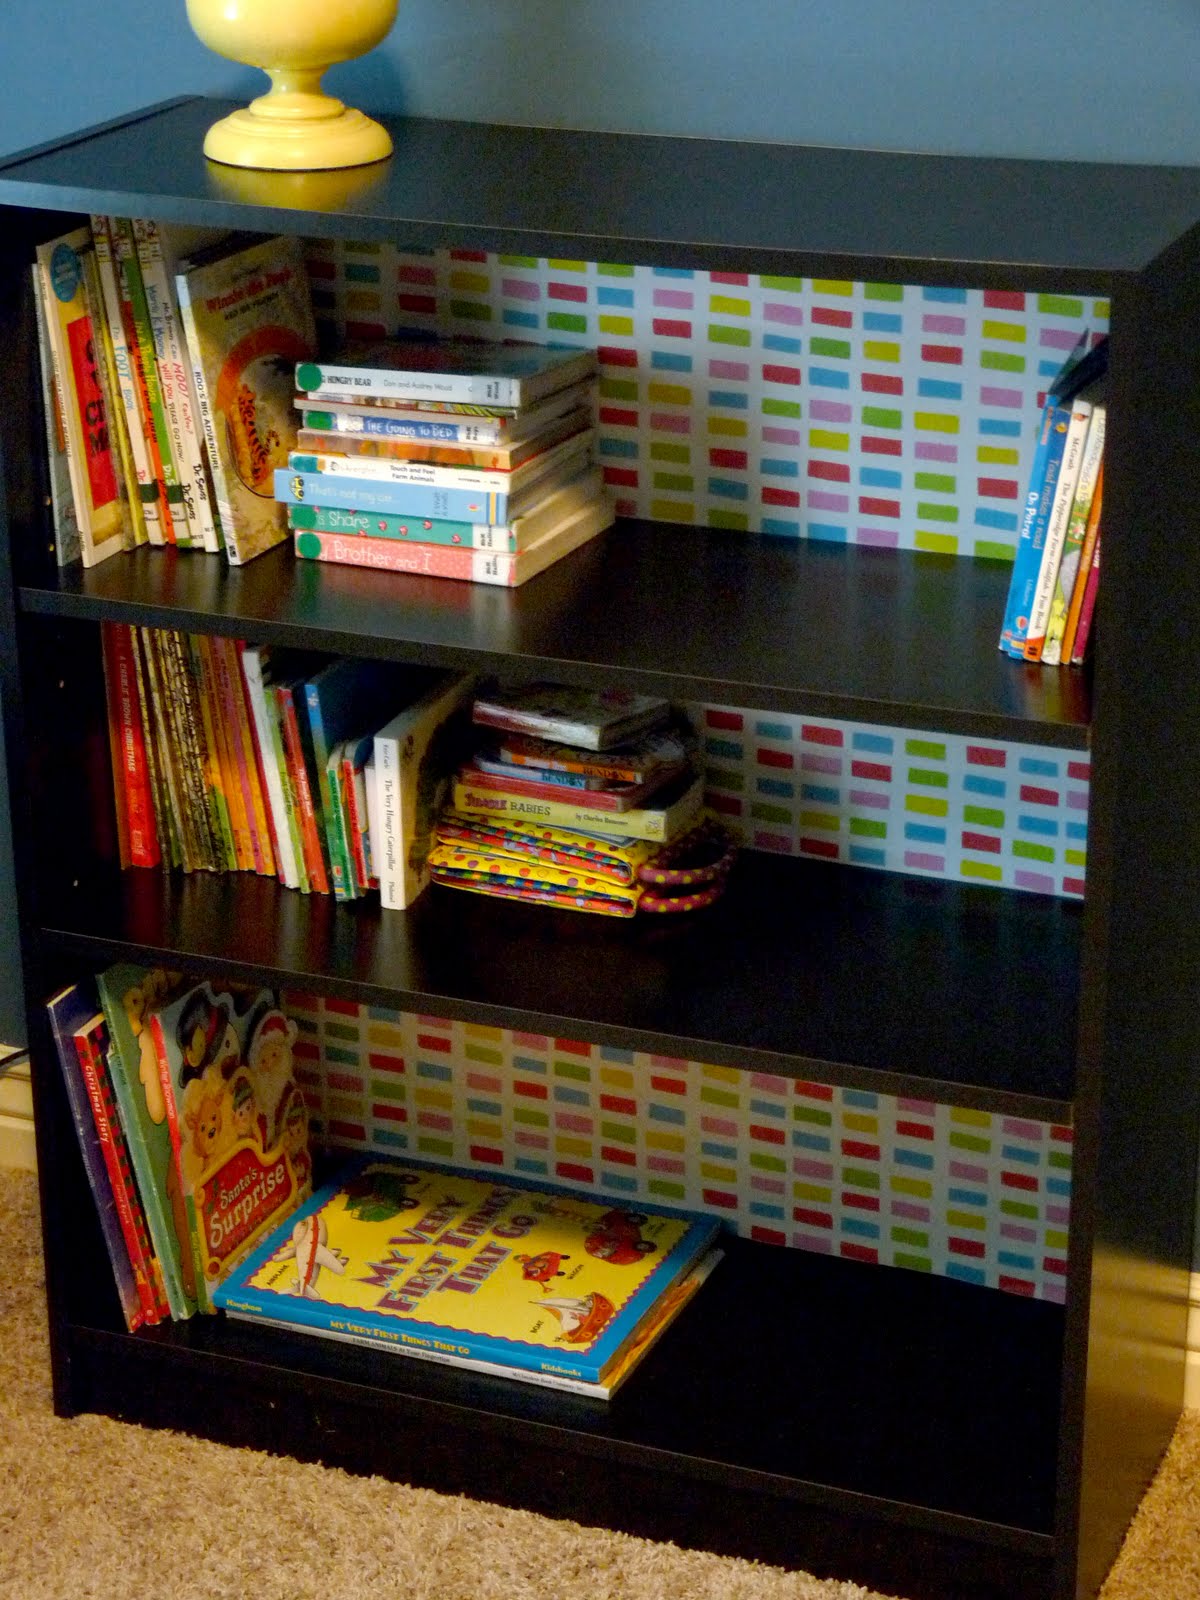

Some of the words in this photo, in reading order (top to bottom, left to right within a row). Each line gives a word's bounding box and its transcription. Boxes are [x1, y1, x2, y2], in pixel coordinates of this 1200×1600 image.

[113, 345, 132, 381] FOOT
[193, 371, 206, 400] ROO'S
[327, 375, 353, 385] HUNGRY
[354, 377, 371, 387] BEAR
[200, 400, 209, 418] BIG
[431, 424, 453, 438] BED
[203, 418, 220, 470] ADVENTURE
[196, 477, 207, 501] Seuss
[409, 474, 435, 482] Animals
[1063, 482, 1071, 495] The
[184, 497, 196, 520] Seuss
[1028, 491, 1039, 506] On
[328, 511, 370, 529] Share
[1021, 506, 1037, 539] Patrol
[334, 541, 392, 566] Brother
[125, 727, 136, 772] CHRISTMAS
[385, 779, 393, 792] The
[384, 794, 393, 808] Very
[510, 801, 551, 816] BABIES
[385, 809, 394, 834] Hungry
[385, 834, 396, 871] Caterpillar
[85, 1065, 102, 1113] Christmas
[98, 1116, 110, 1142] Story
[220, 1166, 258, 1210] Santa's
[210, 1163, 285, 1249] Surprise
[436, 1240, 513, 1294] THAT
[491, 1214, 539, 1240] GO
[266, 1264, 289, 1286] AIRPLANE
[354, 1248, 414, 1288] MY
[377, 1250, 460, 1313] FIRST
[346, 1322, 373, 1336] VERY
[374, 1328, 399, 1341] FIRST
[529, 1320, 545, 1334] BOAT
[541, 1361, 581, 1377] Kidsbooks
